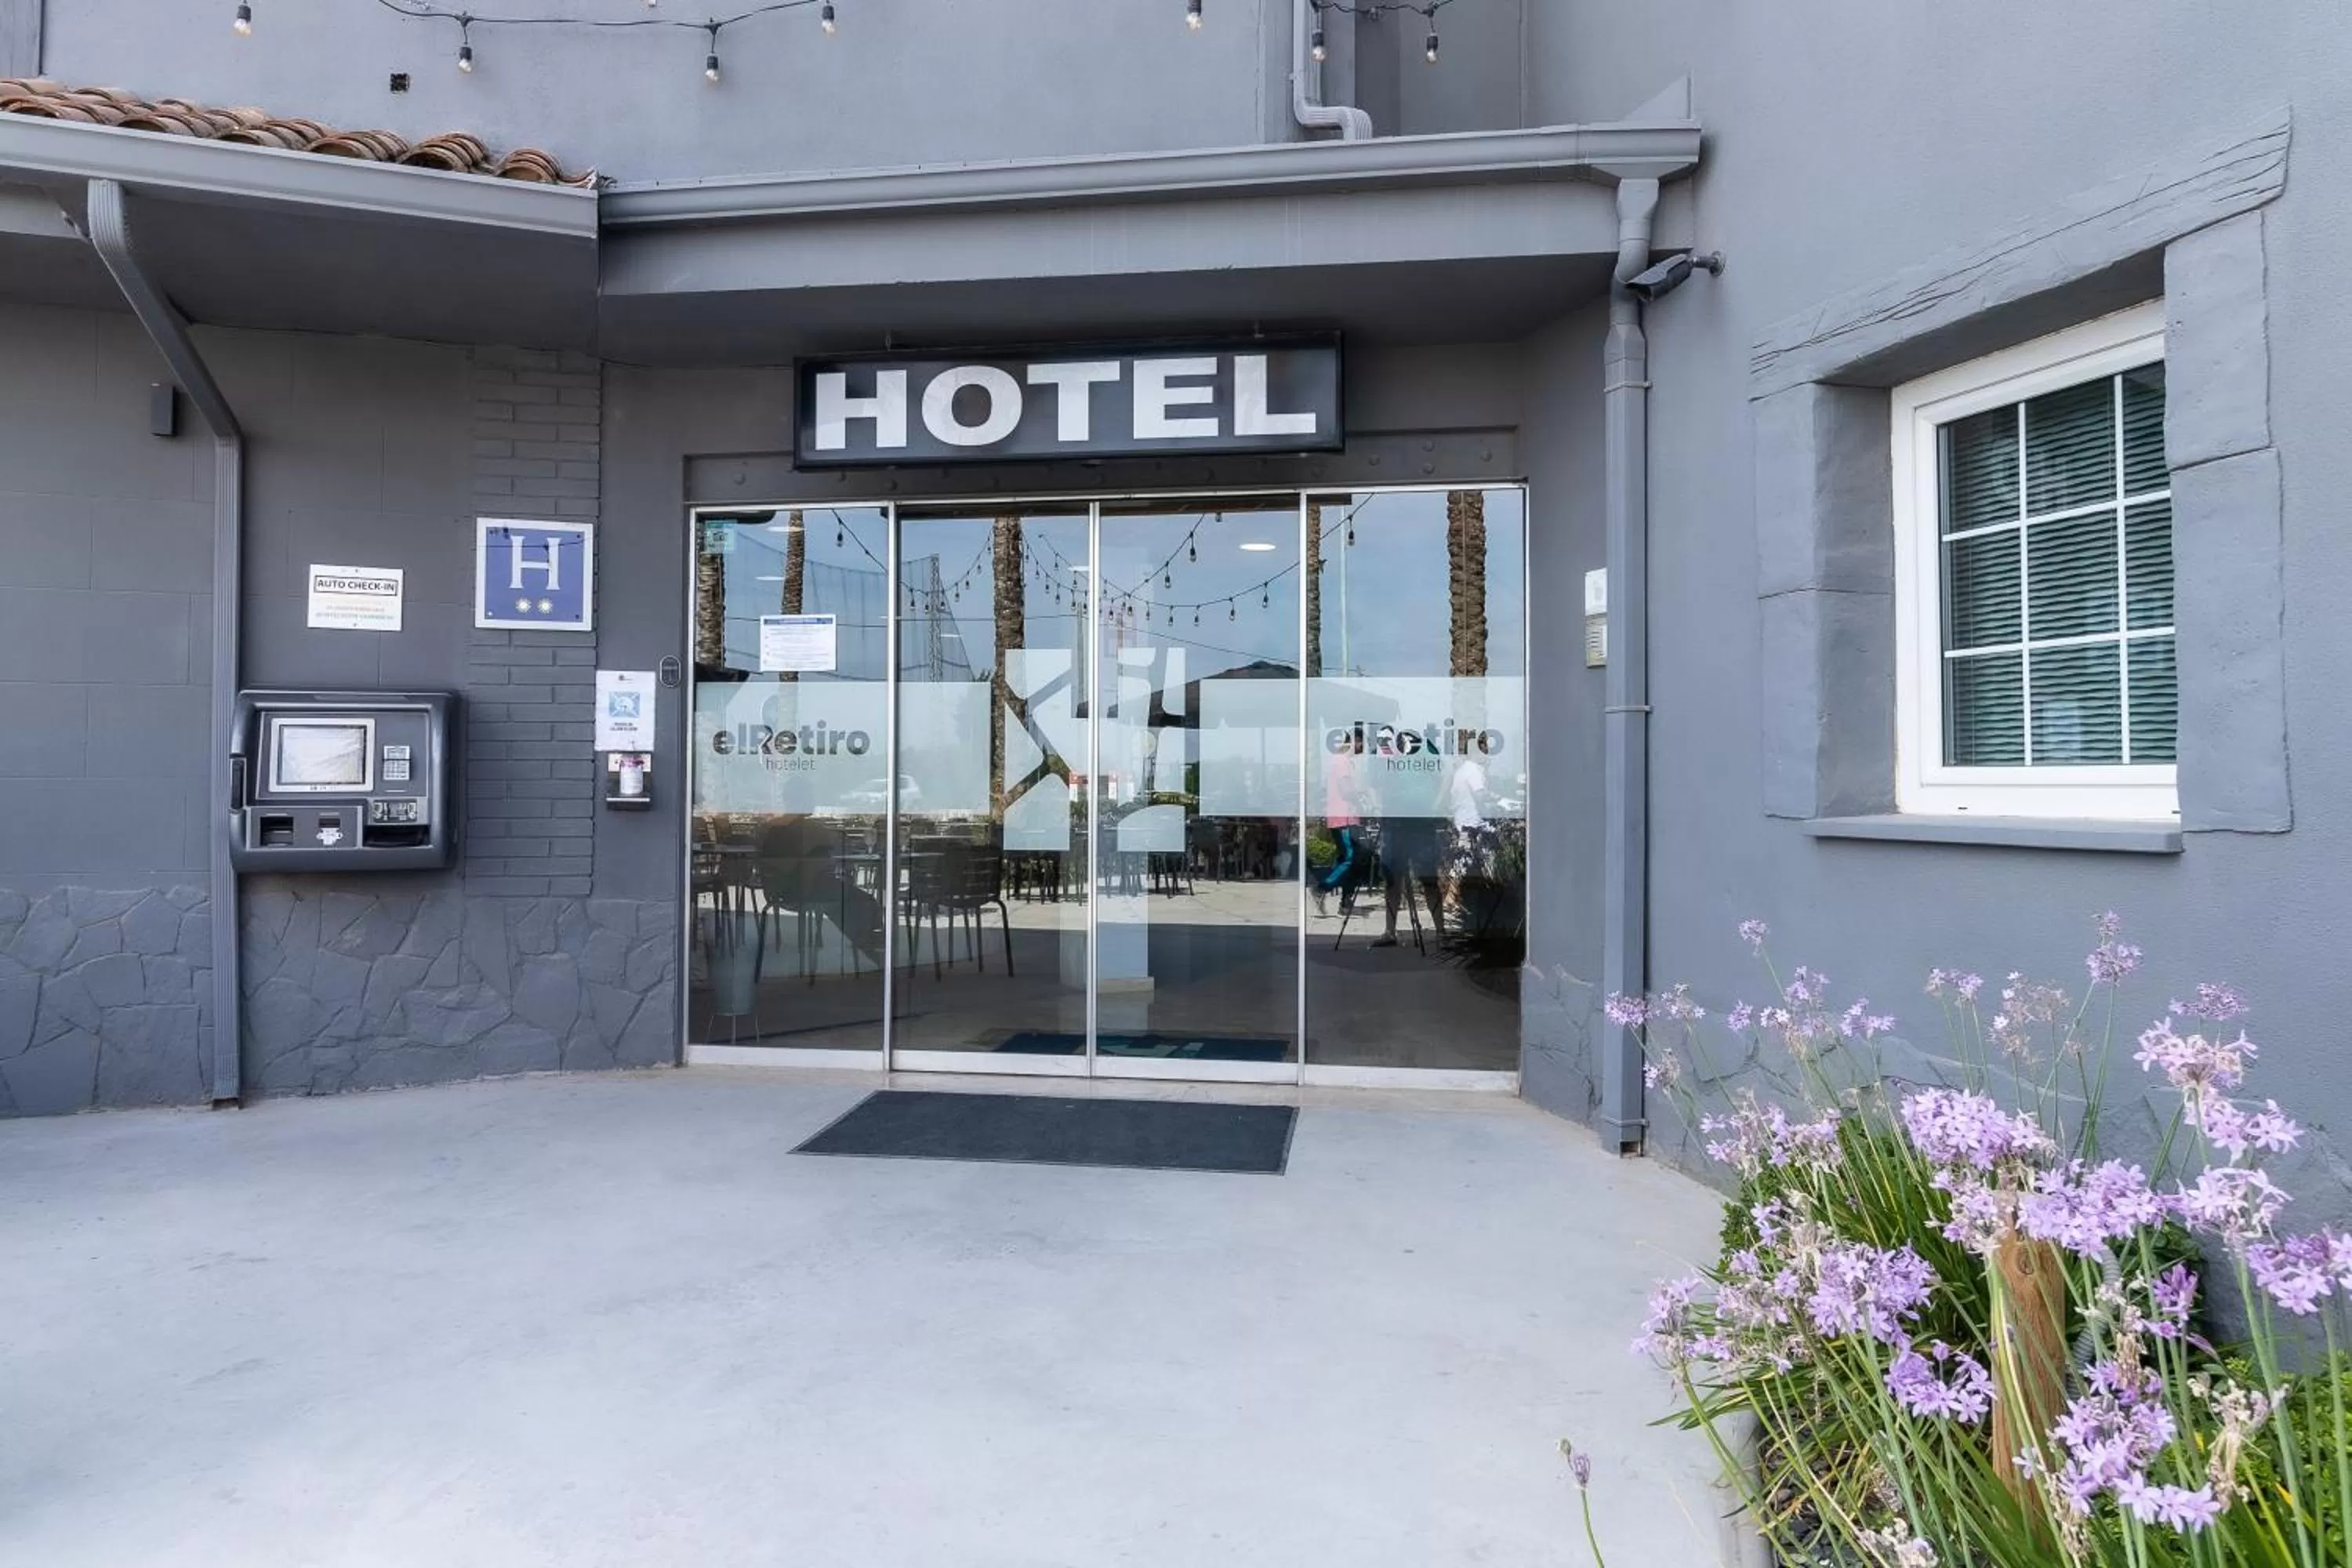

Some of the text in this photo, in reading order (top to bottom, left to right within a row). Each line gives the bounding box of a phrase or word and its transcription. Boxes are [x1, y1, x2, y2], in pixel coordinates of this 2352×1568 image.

[815, 354, 1317, 452] HOTEL
[508, 535, 562, 590] H
[317, 579, 394, 590] AUTO CHECK-IN
[713, 719, 870, 755] elRetiro
[1326, 717, 1504, 756] elRetiro
[766, 757, 816, 771] hotelet
[1387, 758, 1442, 772] hotelet
